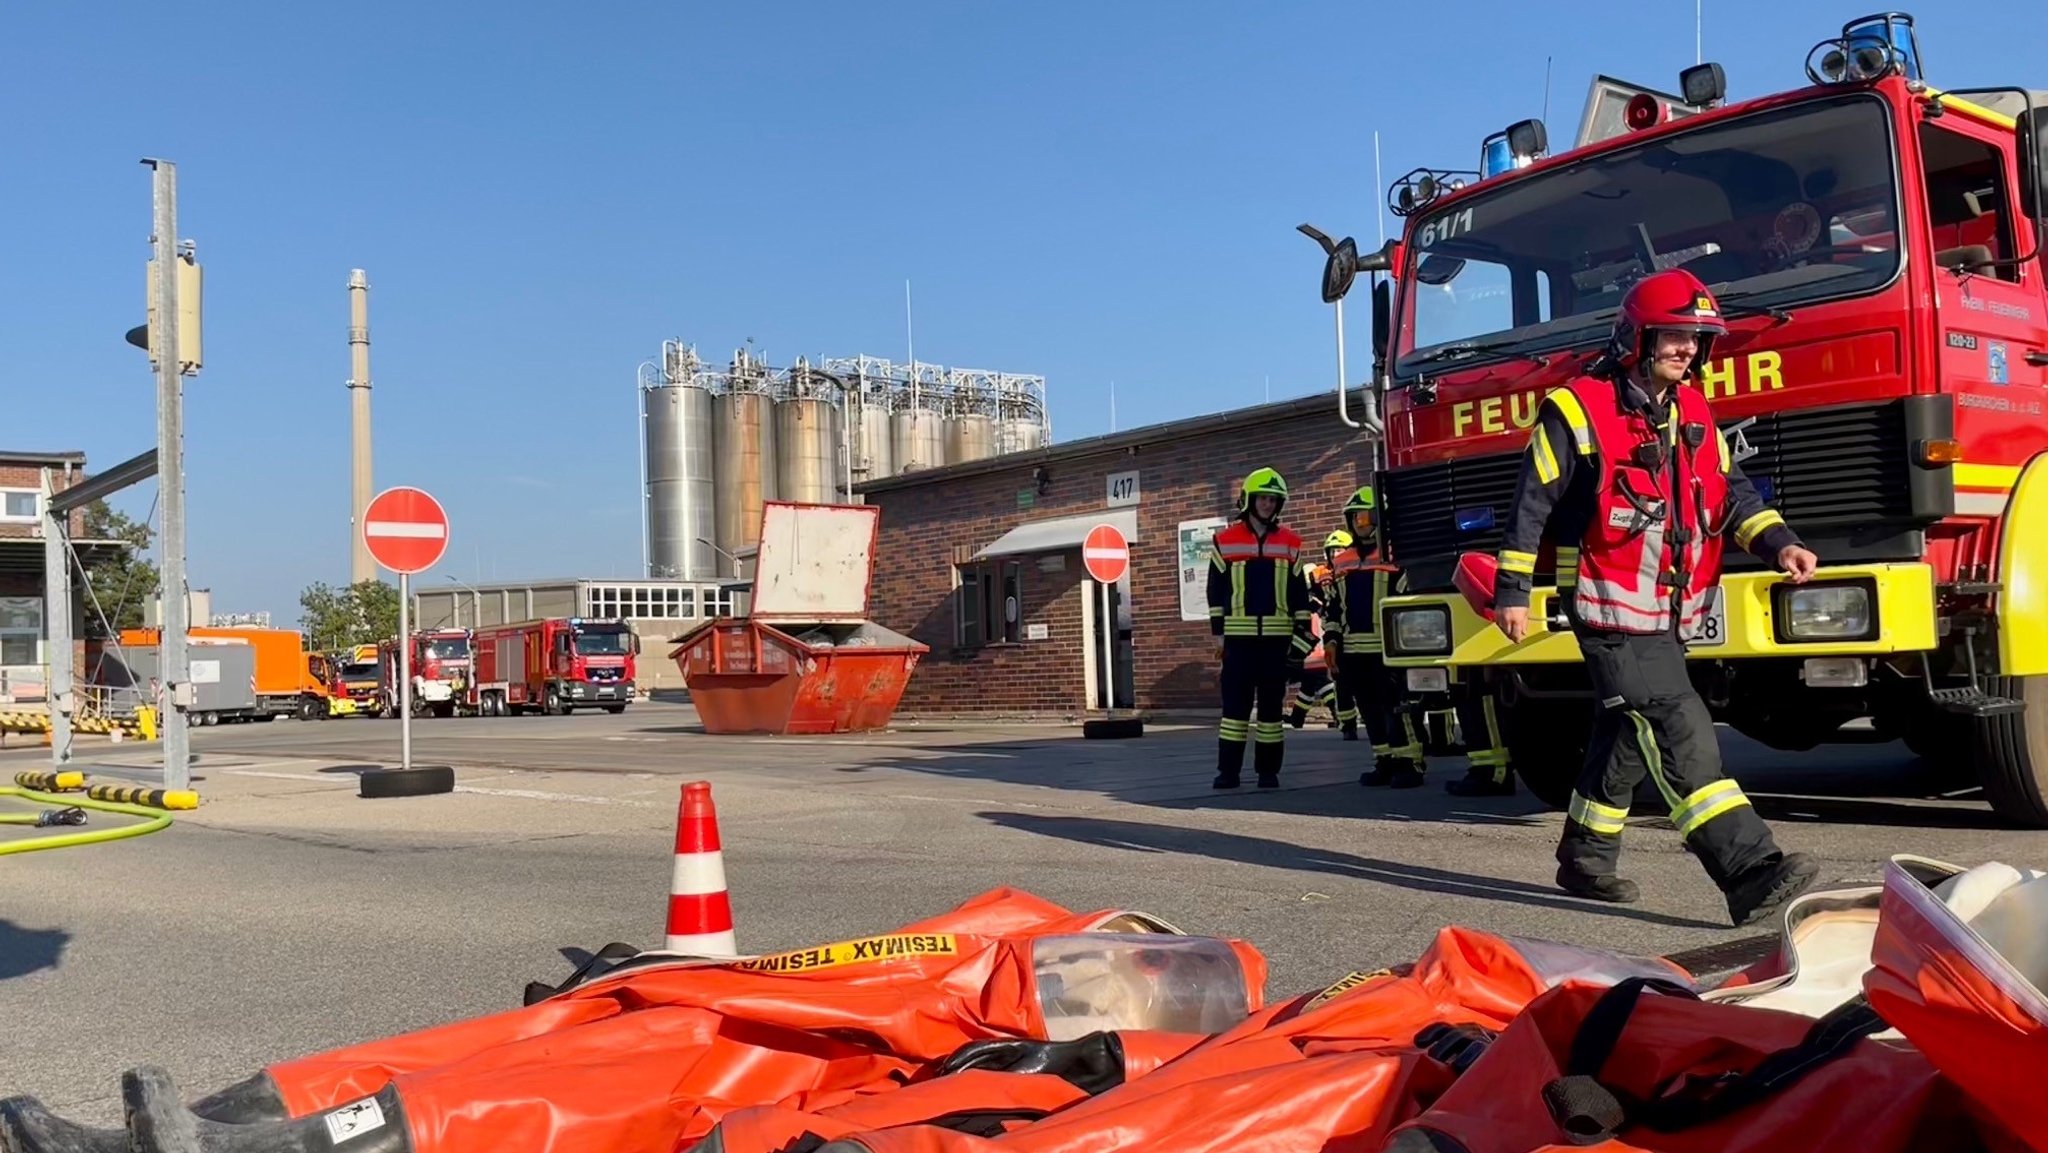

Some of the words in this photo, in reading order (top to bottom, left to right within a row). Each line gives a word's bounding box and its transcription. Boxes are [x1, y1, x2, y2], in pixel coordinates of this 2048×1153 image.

[1422, 207, 1473, 247] 61/1
[1113, 477, 1133, 500] 417
[853, 936, 952, 959] TESIMAX
